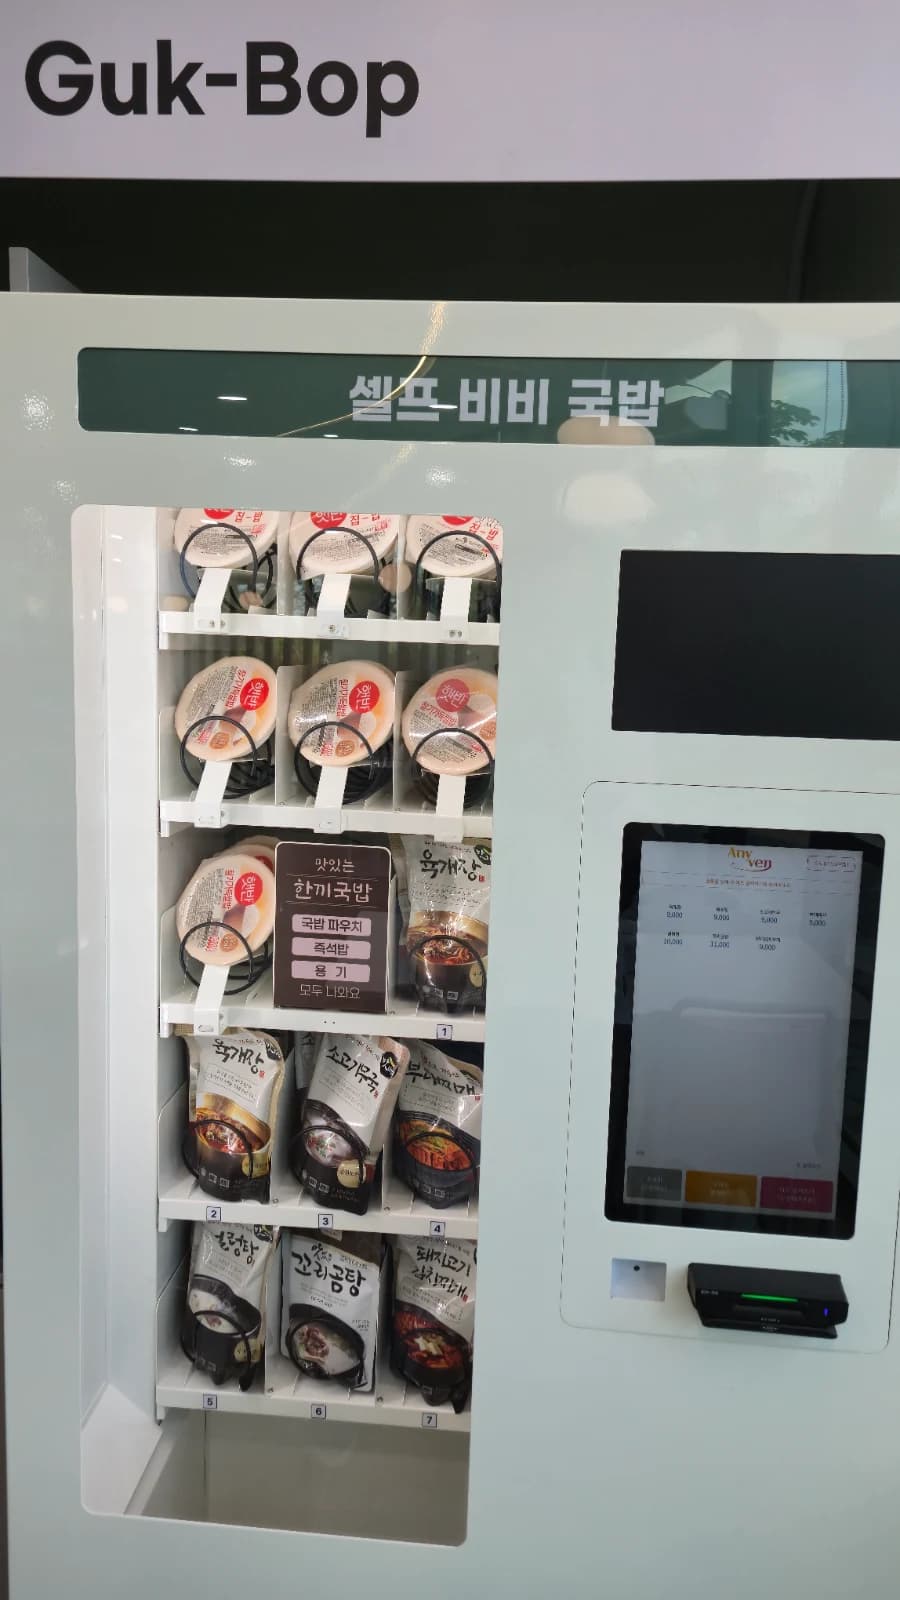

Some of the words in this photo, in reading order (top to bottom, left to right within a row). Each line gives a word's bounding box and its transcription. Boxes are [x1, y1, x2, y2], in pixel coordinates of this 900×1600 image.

[24, 40, 420, 138] Guk-Bop
[350, 376, 440, 421] 셀프
[459, 378, 549, 424] 비비
[568, 379, 664, 427] 국밥
[244, 681, 265, 708] 햇반
[355, 684, 372, 711] 햇반
[438, 684, 466, 709] 햇반
[315, 857, 355, 873] 맛있는
[420, 849, 482, 882] 육개장
[728, 847, 752, 860] Any
[748, 858, 772, 869] ven
[240, 876, 257, 904] 햇반
[293, 878, 373, 903] 한끼국밥
[301, 916, 325, 930] 국밥
[328, 918, 362, 933] 파우치
[313, 942, 349, 956] 즉석밥
[315, 964, 327, 977] 용
[336, 966, 347, 978] 기
[300, 984, 323, 996] 모두
[326, 985, 360, 999] 나와요
[212, 1039, 264, 1075] 육개장
[325, 1045, 379, 1093] 소고기무국
[214, 1230, 259, 1265] 설렁탕
[416, 1245, 471, 1277] 돼지고기
[291, 1251, 367, 1297] 꼬리곰탕
[411, 1265, 468, 1298] 김치찌개
